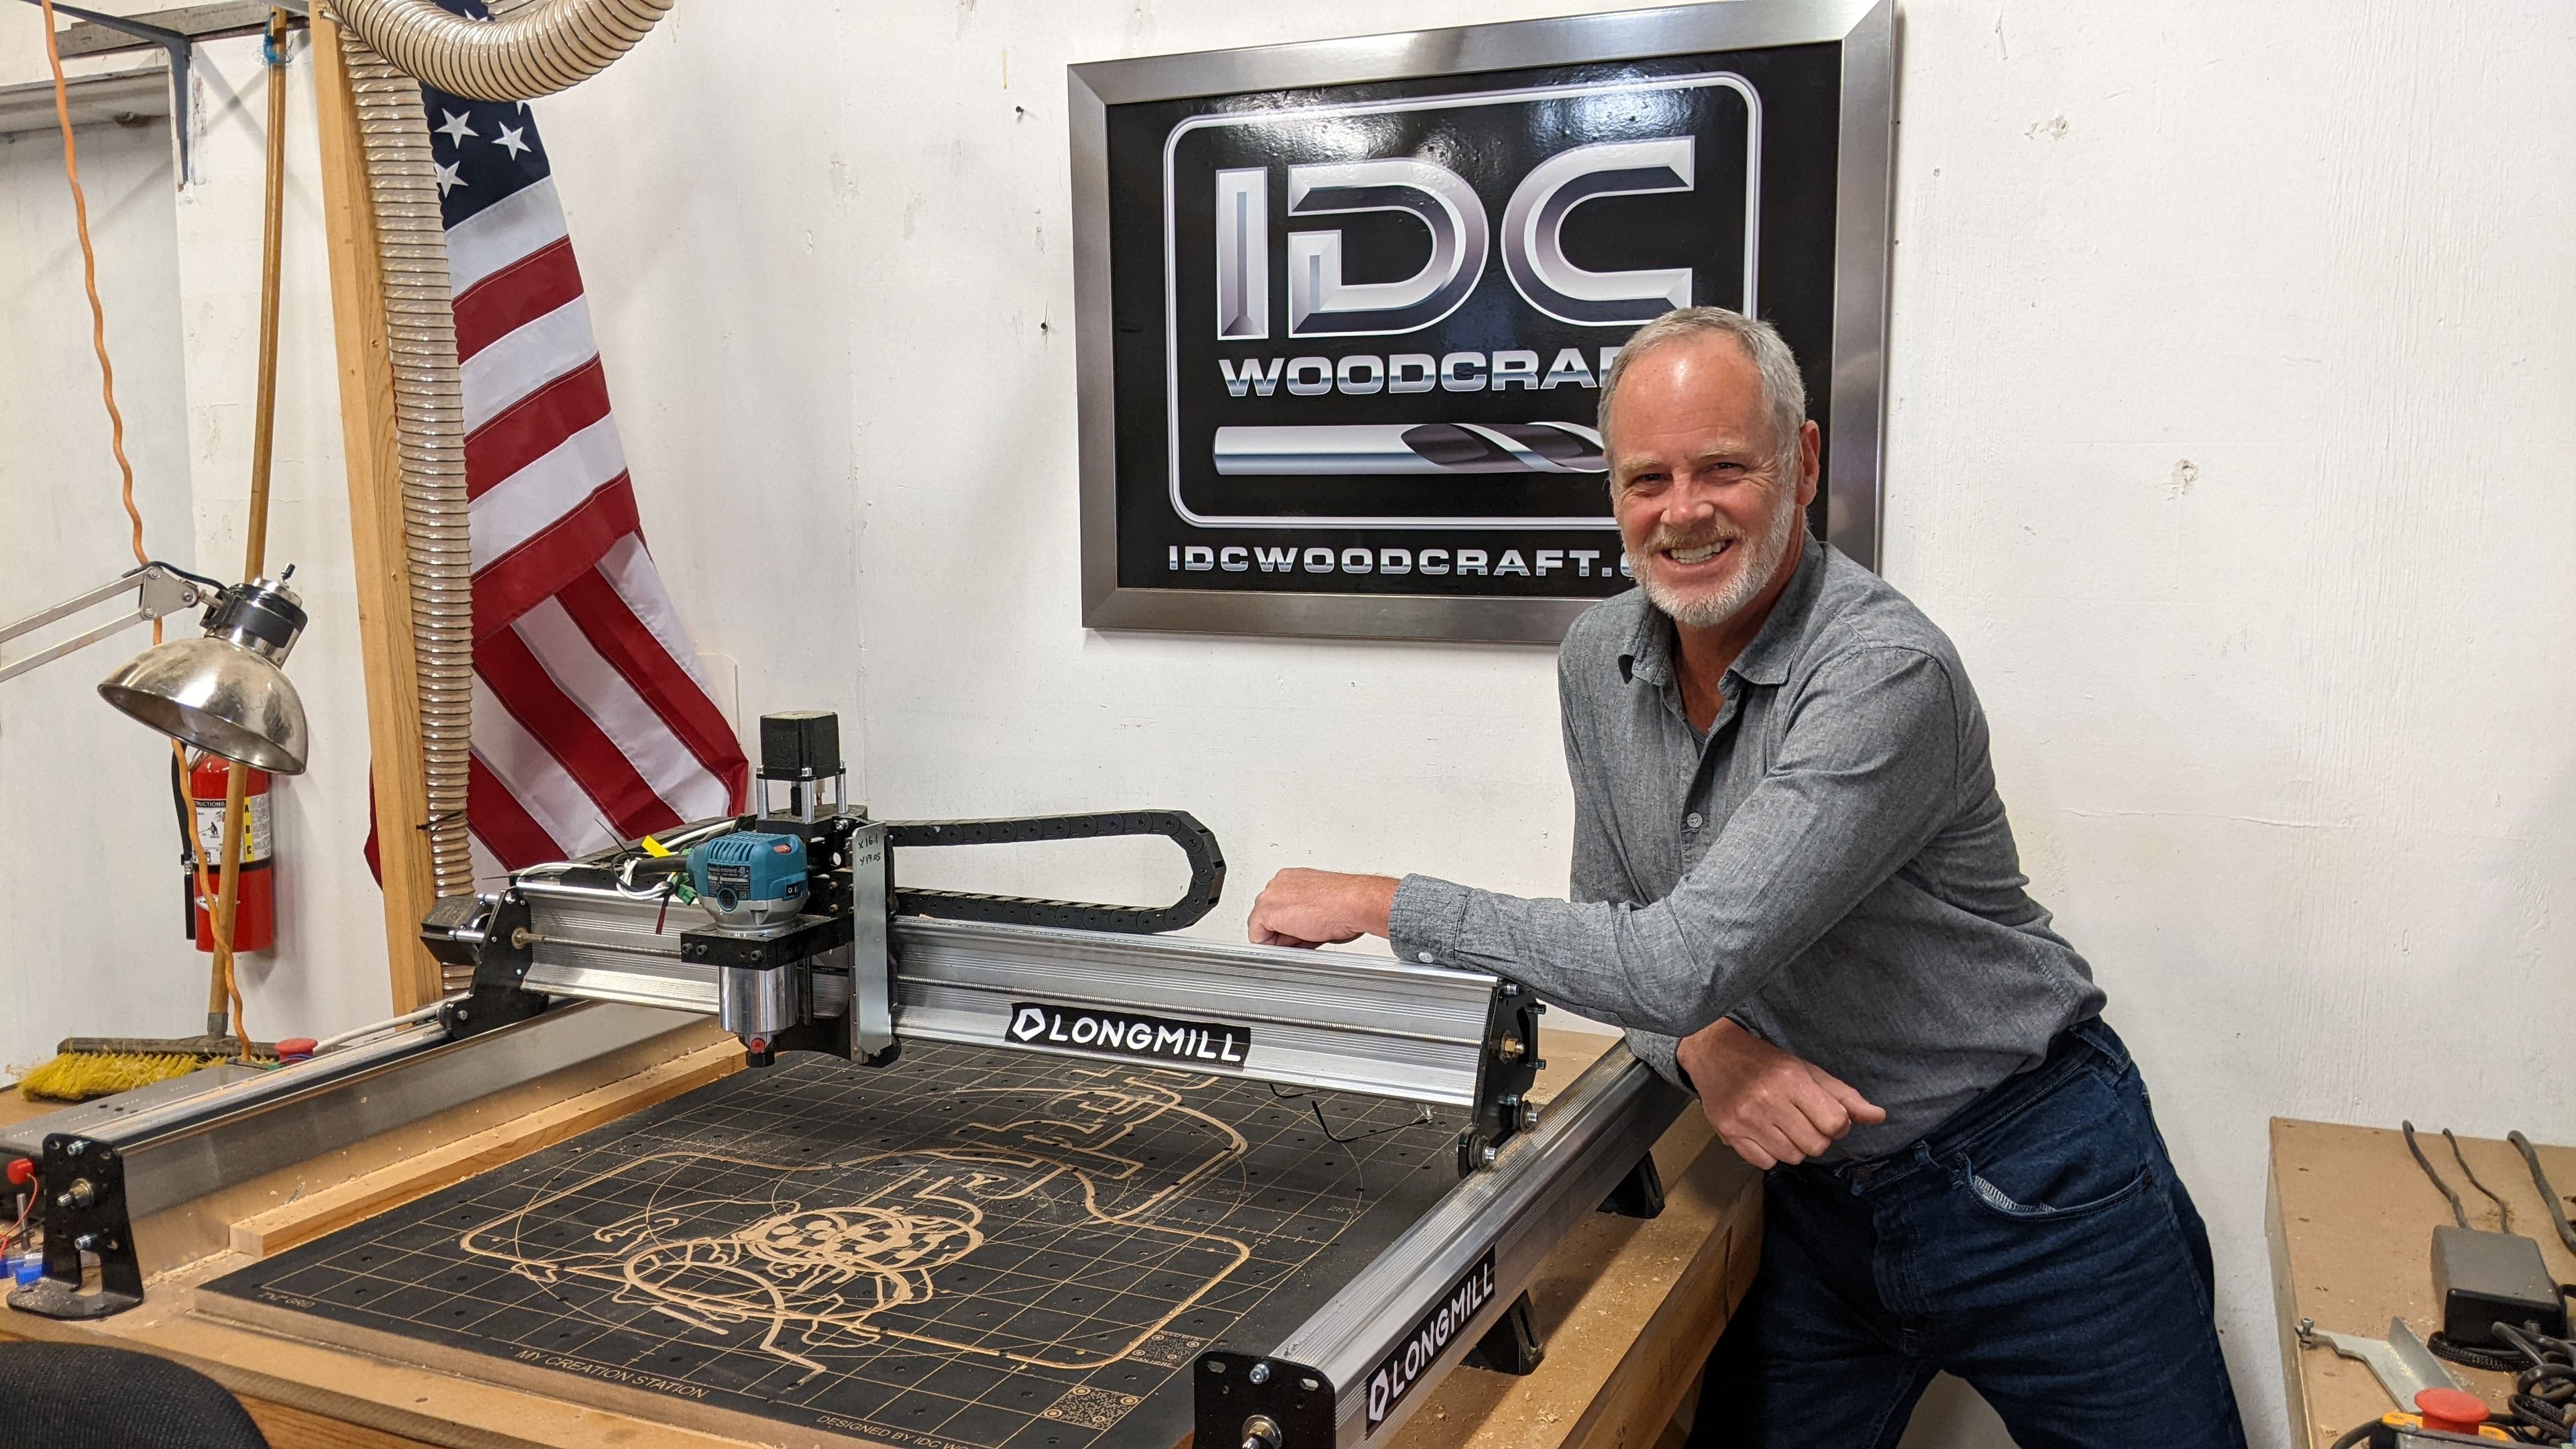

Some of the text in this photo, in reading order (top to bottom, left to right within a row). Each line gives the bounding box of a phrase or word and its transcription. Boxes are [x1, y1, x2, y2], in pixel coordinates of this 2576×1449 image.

[1216, 136, 1695, 340] IDC
[244, 804, 249, 814] A
[246, 824, 250, 834] B
[247, 845, 252, 855] C
[1049, 1014, 1242, 1062] LONGMILL
[1393, 1263, 1493, 1398] LONGMILL
[515, 1350, 710, 1399] MY CREATION STATION
[816, 1415, 891, 1436] DESIGNED
[890, 1432, 915, 1442] BY
[914, 1437, 942, 1448] IDC
